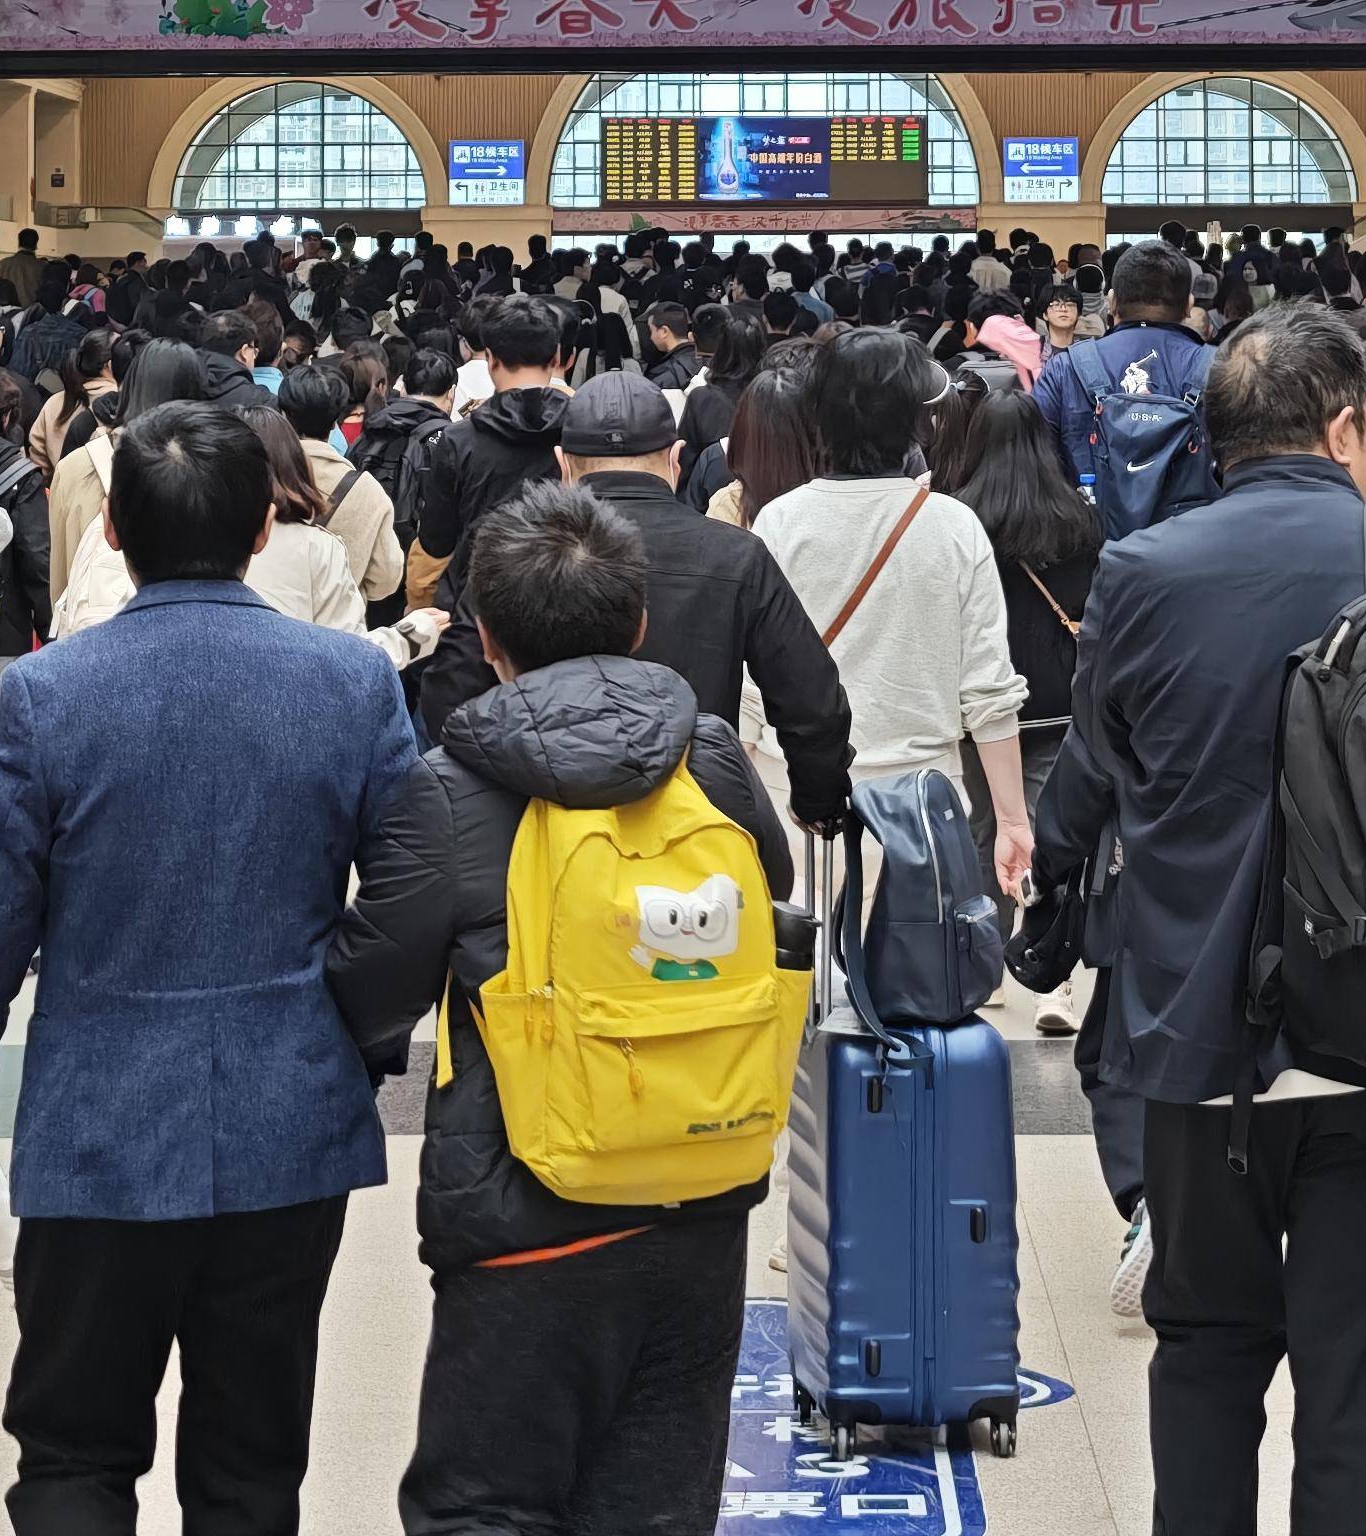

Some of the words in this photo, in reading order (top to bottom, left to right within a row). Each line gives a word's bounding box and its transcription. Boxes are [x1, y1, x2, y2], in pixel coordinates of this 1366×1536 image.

[471, 145, 519, 157] 18候车区
[1026, 143, 1074, 155] 18候车区
[489, 181, 519, 191] 卫生间
[1026, 179, 1055, 188] 卫生间
